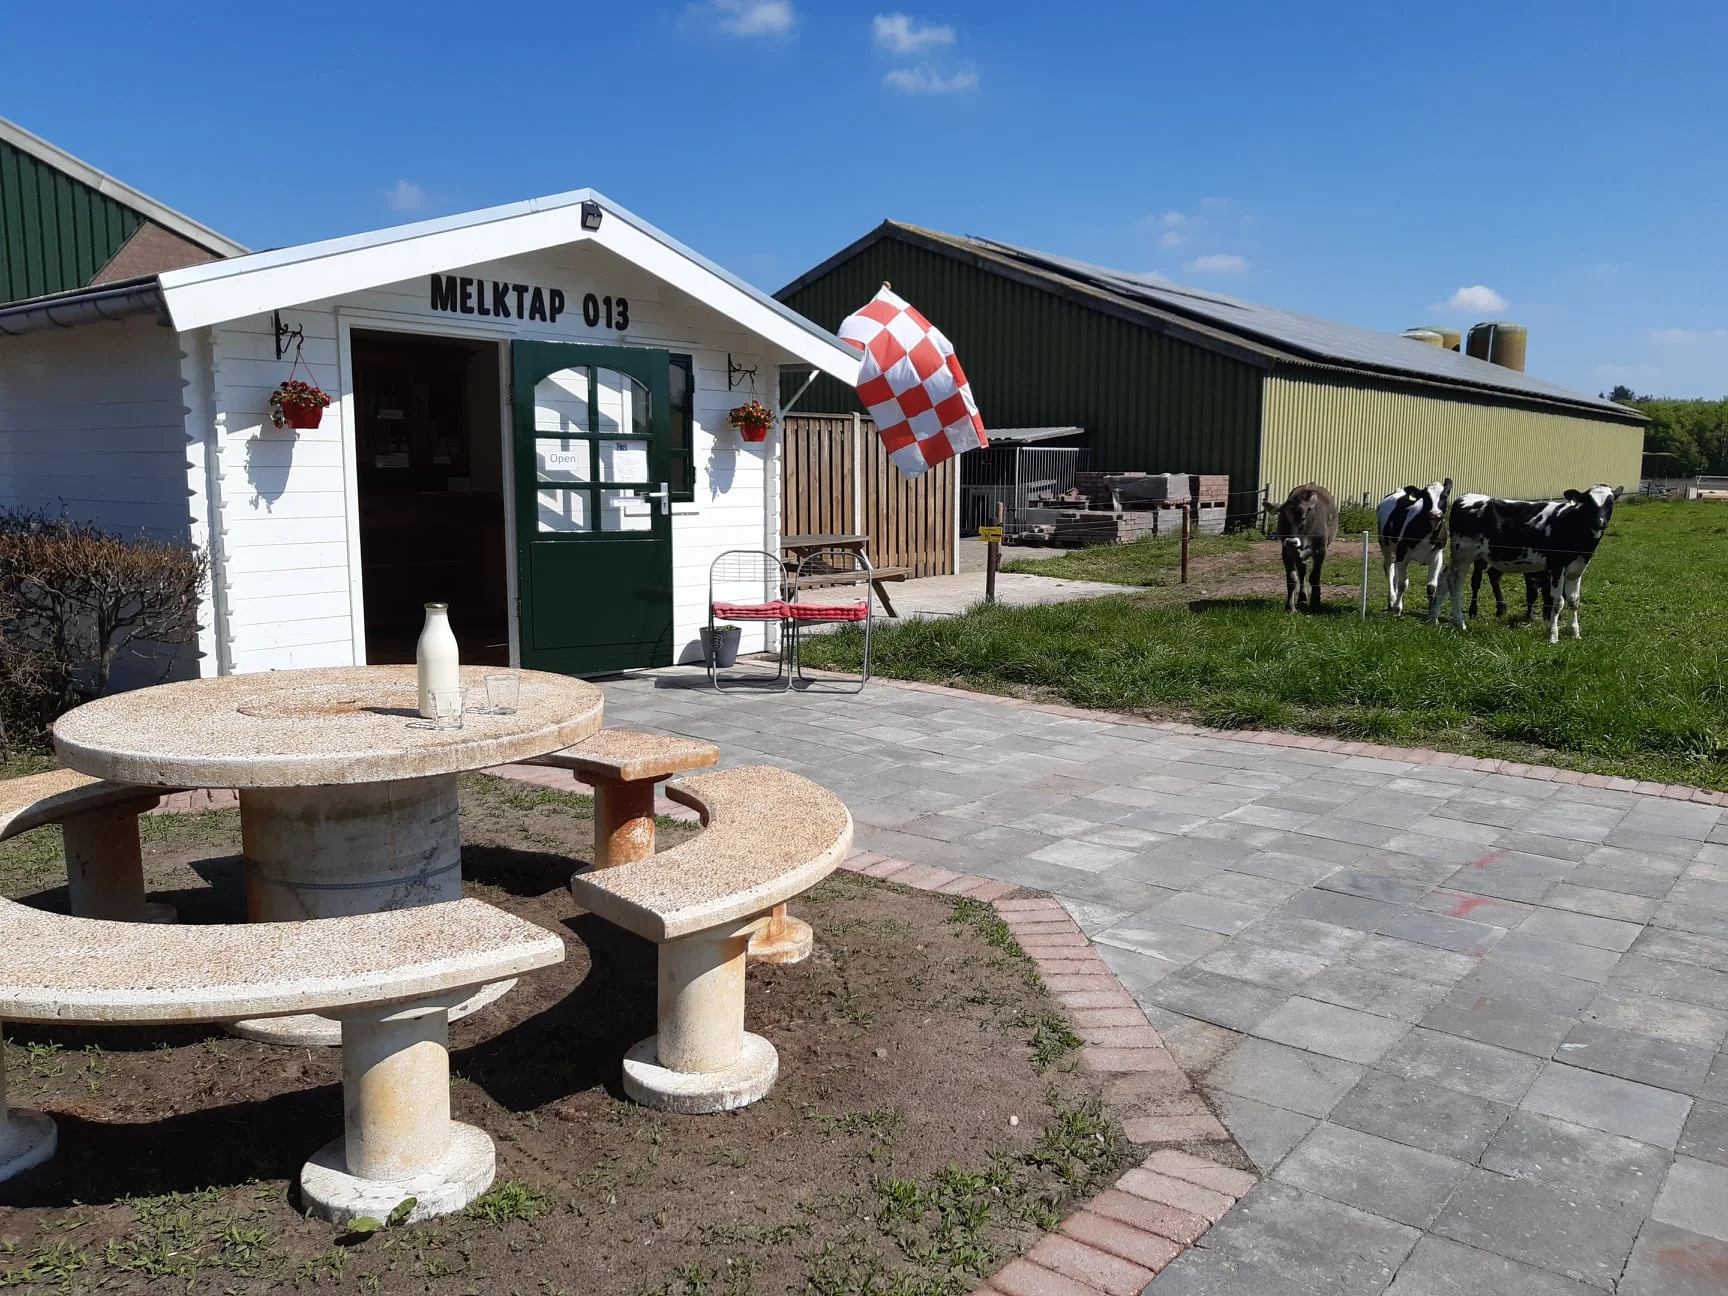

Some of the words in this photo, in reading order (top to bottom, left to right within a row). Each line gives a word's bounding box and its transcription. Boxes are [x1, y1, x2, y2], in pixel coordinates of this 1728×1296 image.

[431, 273, 565, 323] MELKTAP
[583, 293, 629, 331] 013
[550, 453, 576, 464] Open
